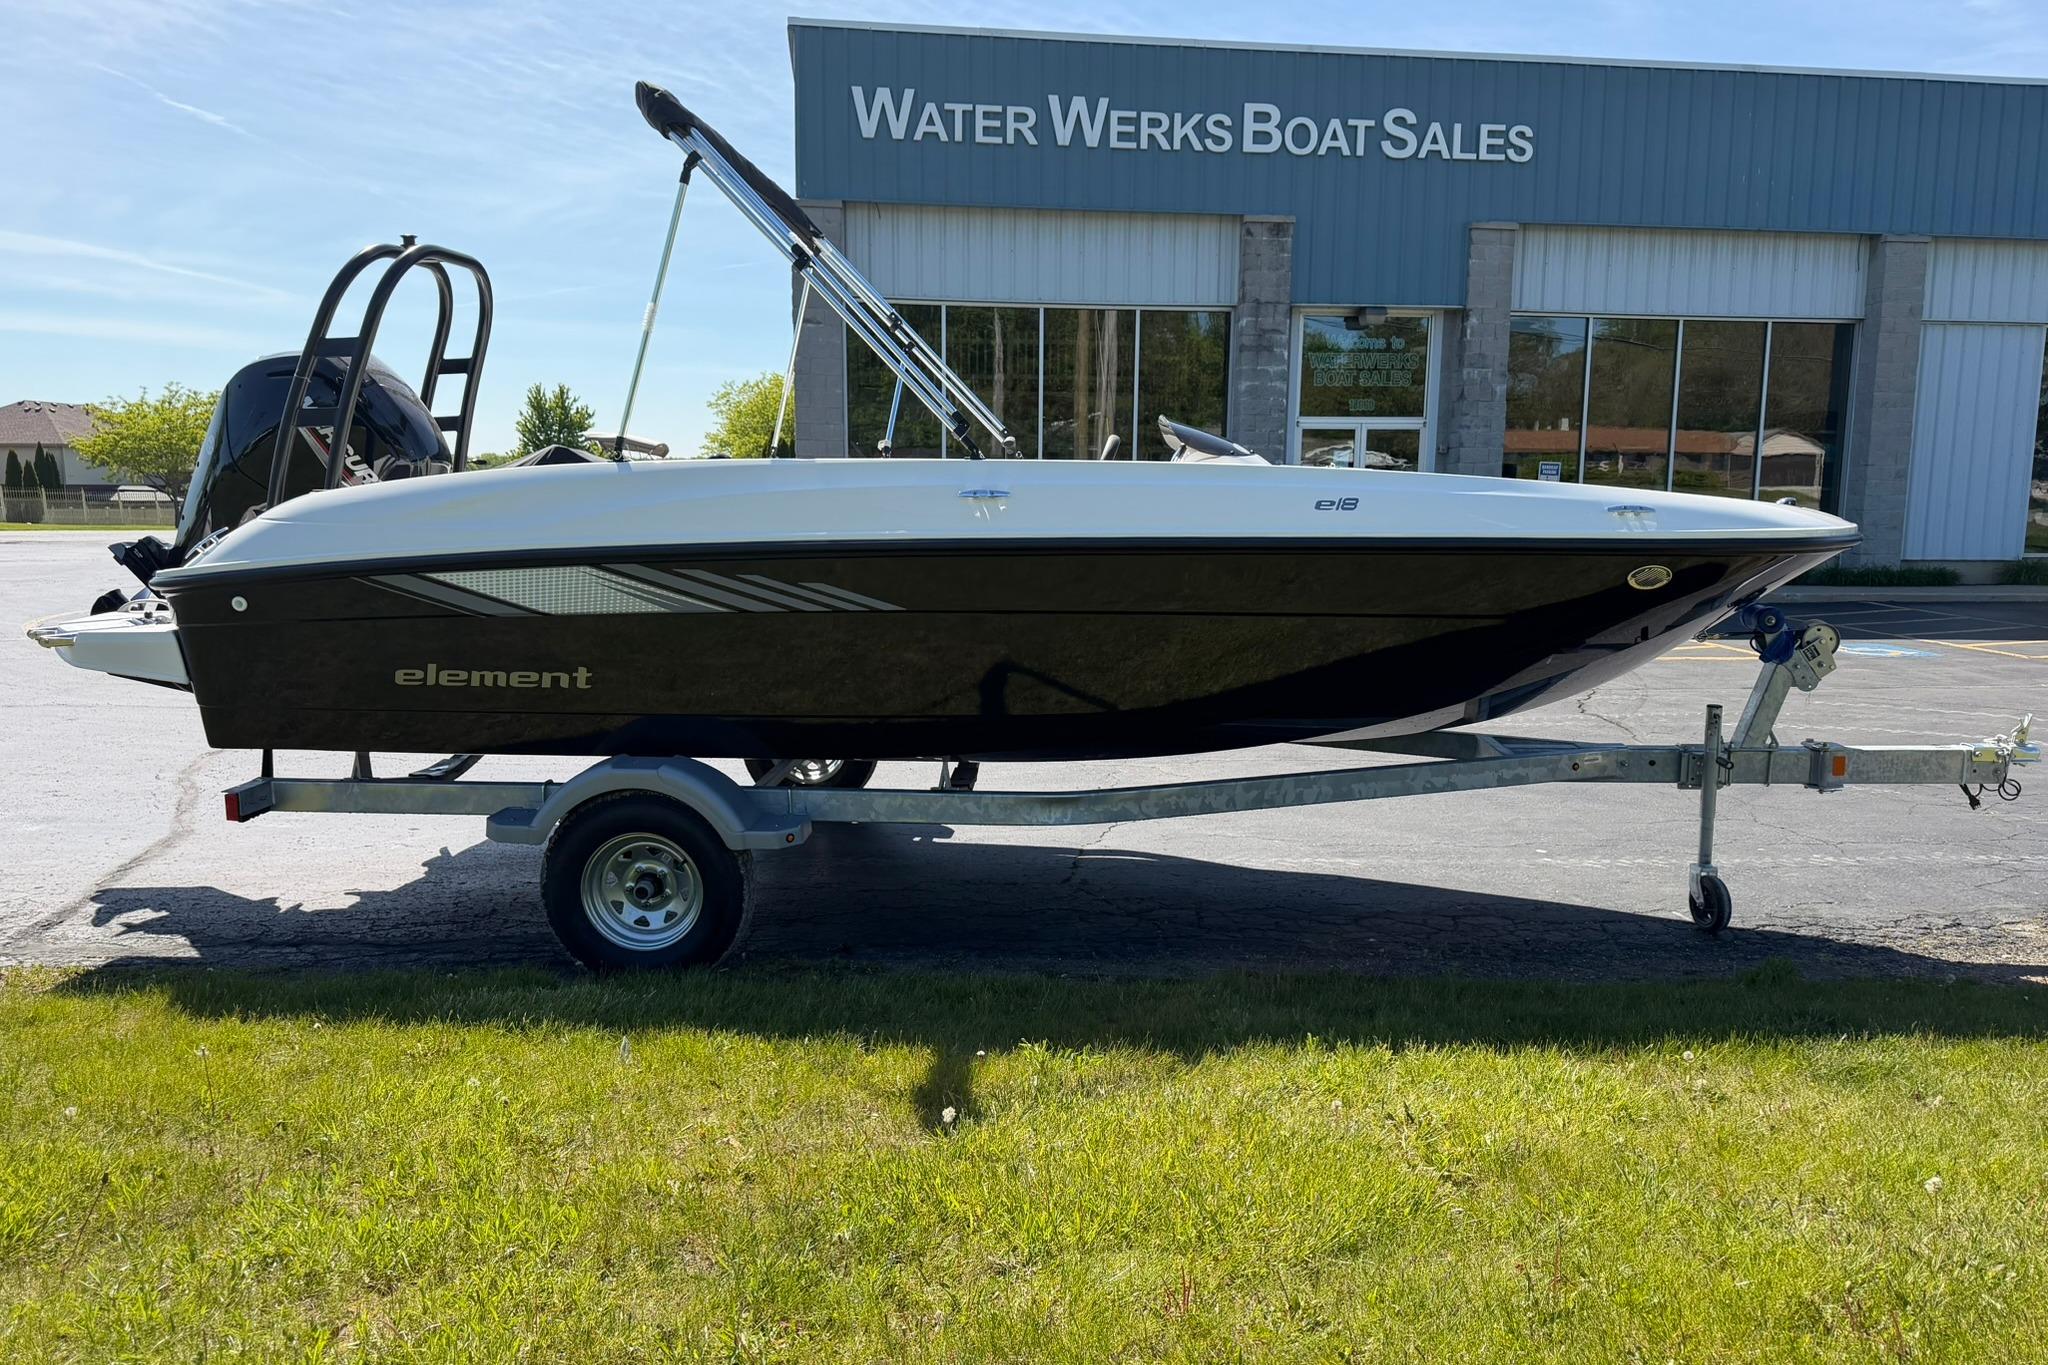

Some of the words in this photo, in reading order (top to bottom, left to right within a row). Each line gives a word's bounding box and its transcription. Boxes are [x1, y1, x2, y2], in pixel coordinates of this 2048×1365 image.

[851, 86, 1038, 145] WATER
[1048, 94, 1234, 152] WERKS
[1242, 102, 1375, 156] BOAT
[1381, 108, 1534, 163] SALES
[1391, 335, 1405, 350] to
[1308, 352, 1419, 369] WATERWERKS
[1313, 370, 1357, 387] BOAT
[1359, 370, 1412, 387] SALES
[394, 663, 593, 689] element
